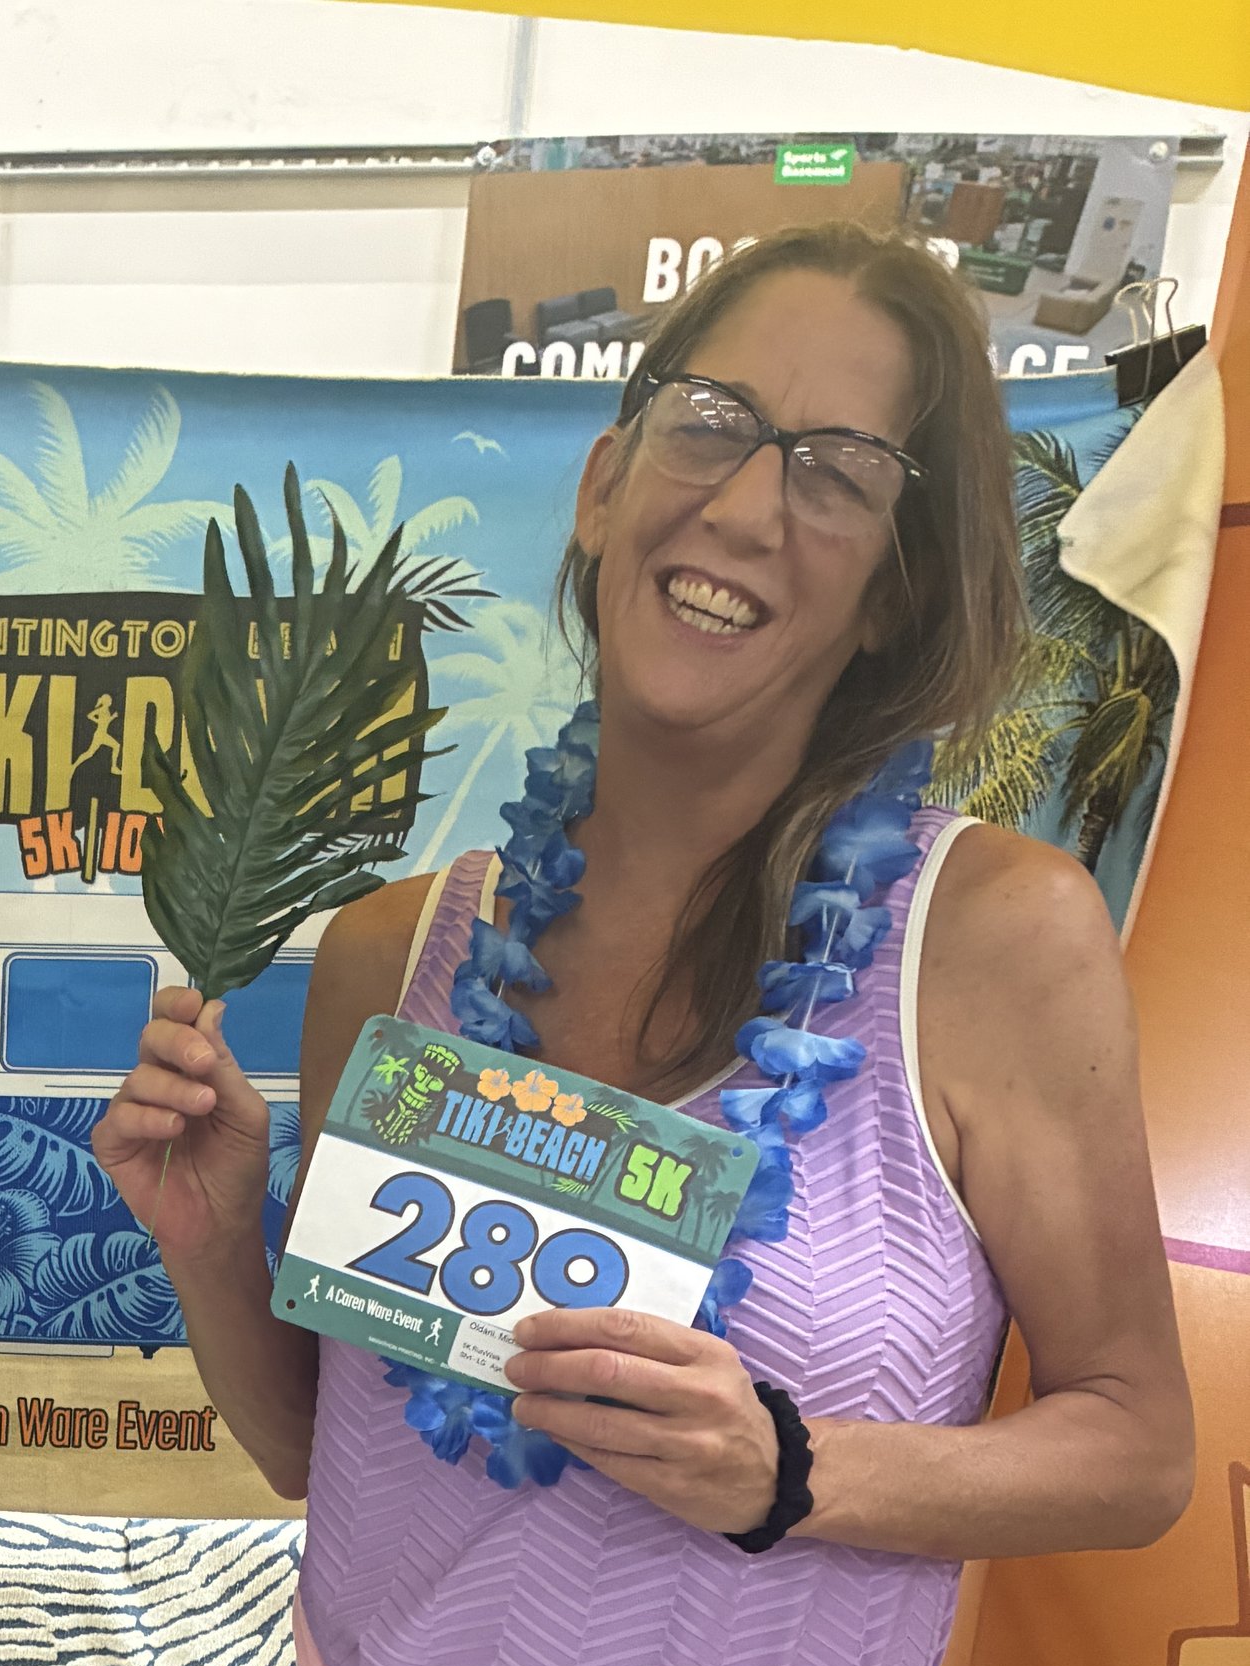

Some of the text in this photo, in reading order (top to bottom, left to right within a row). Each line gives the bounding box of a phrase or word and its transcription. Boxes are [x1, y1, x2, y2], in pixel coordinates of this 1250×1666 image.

[436, 1089, 608, 1182] TIKI BEACH
[619, 1143, 693, 1217] 5K
[345, 1171, 630, 1317] 289
[325, 1285, 424, 1333] A Caren Ware Event
[17, 1397, 109, 1450] Ware
[116, 1400, 217, 1451] Event
